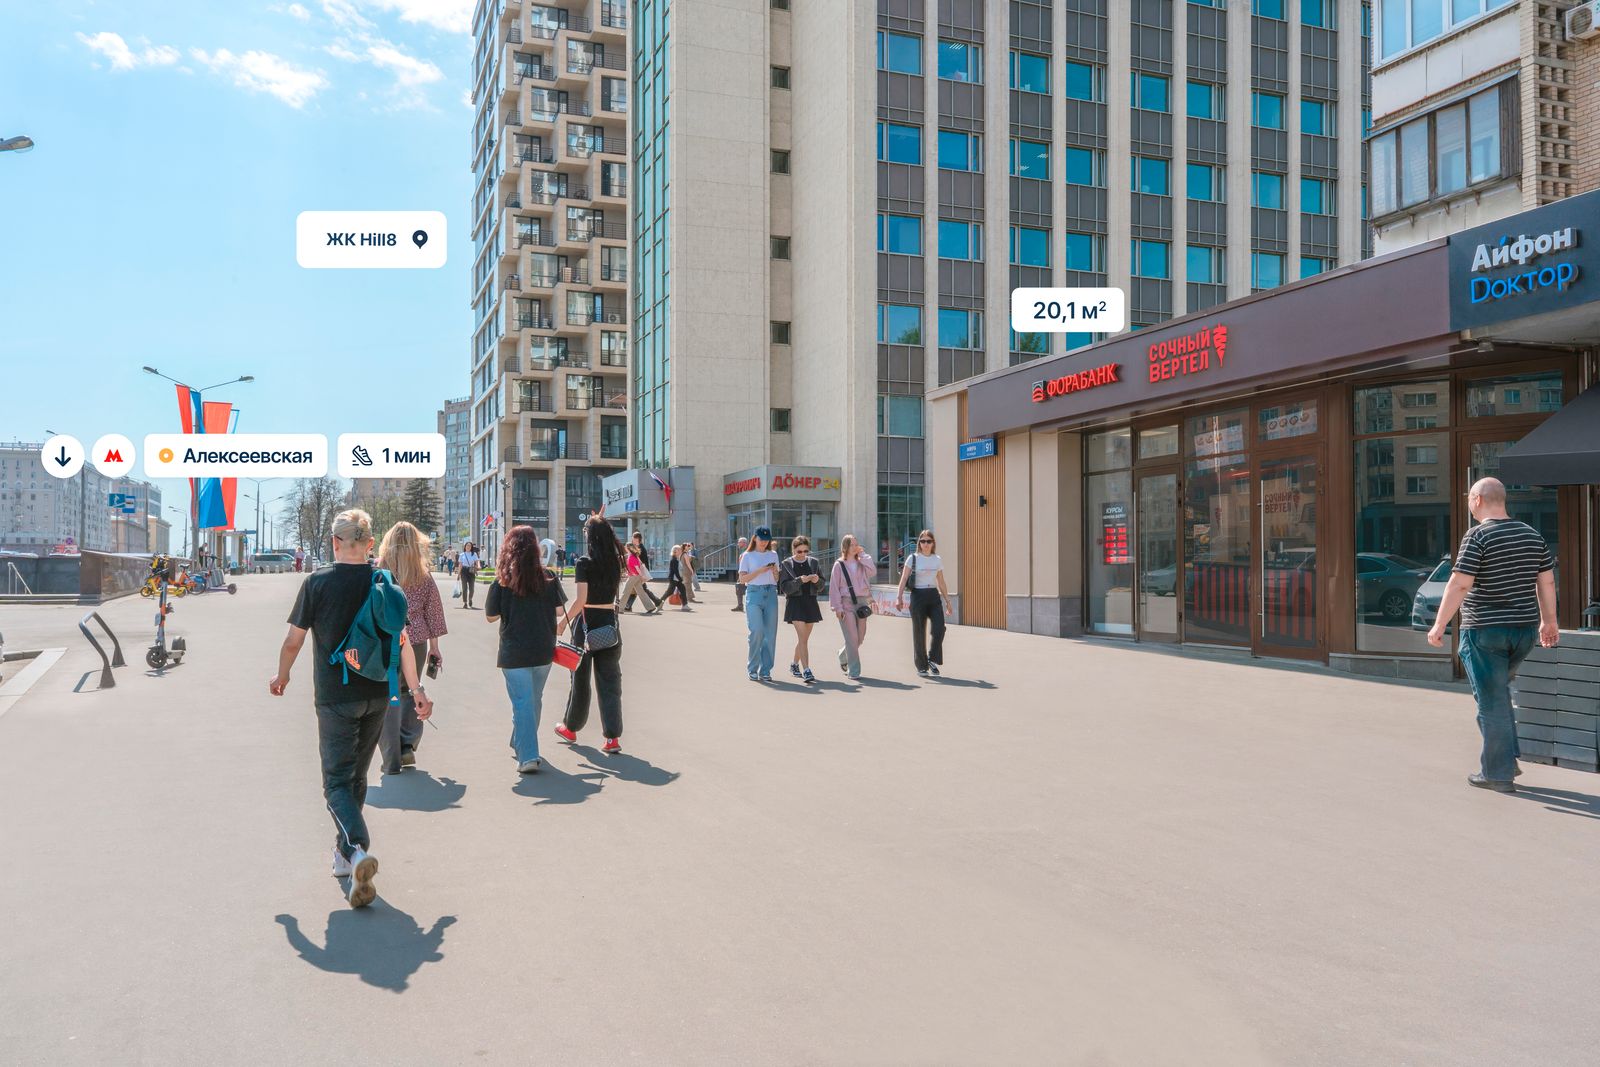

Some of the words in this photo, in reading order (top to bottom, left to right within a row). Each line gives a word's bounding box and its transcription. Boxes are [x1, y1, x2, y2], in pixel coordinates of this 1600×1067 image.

[1471, 227, 1575, 272] Айфон
[1149, 325, 1211, 362] СОЧНЫЙ
[1046, 362, 1119, 397] ФОРАБАНК
[1149, 350, 1209, 384] ВЕРТЕЛ
[985, 442, 992, 453] 91
